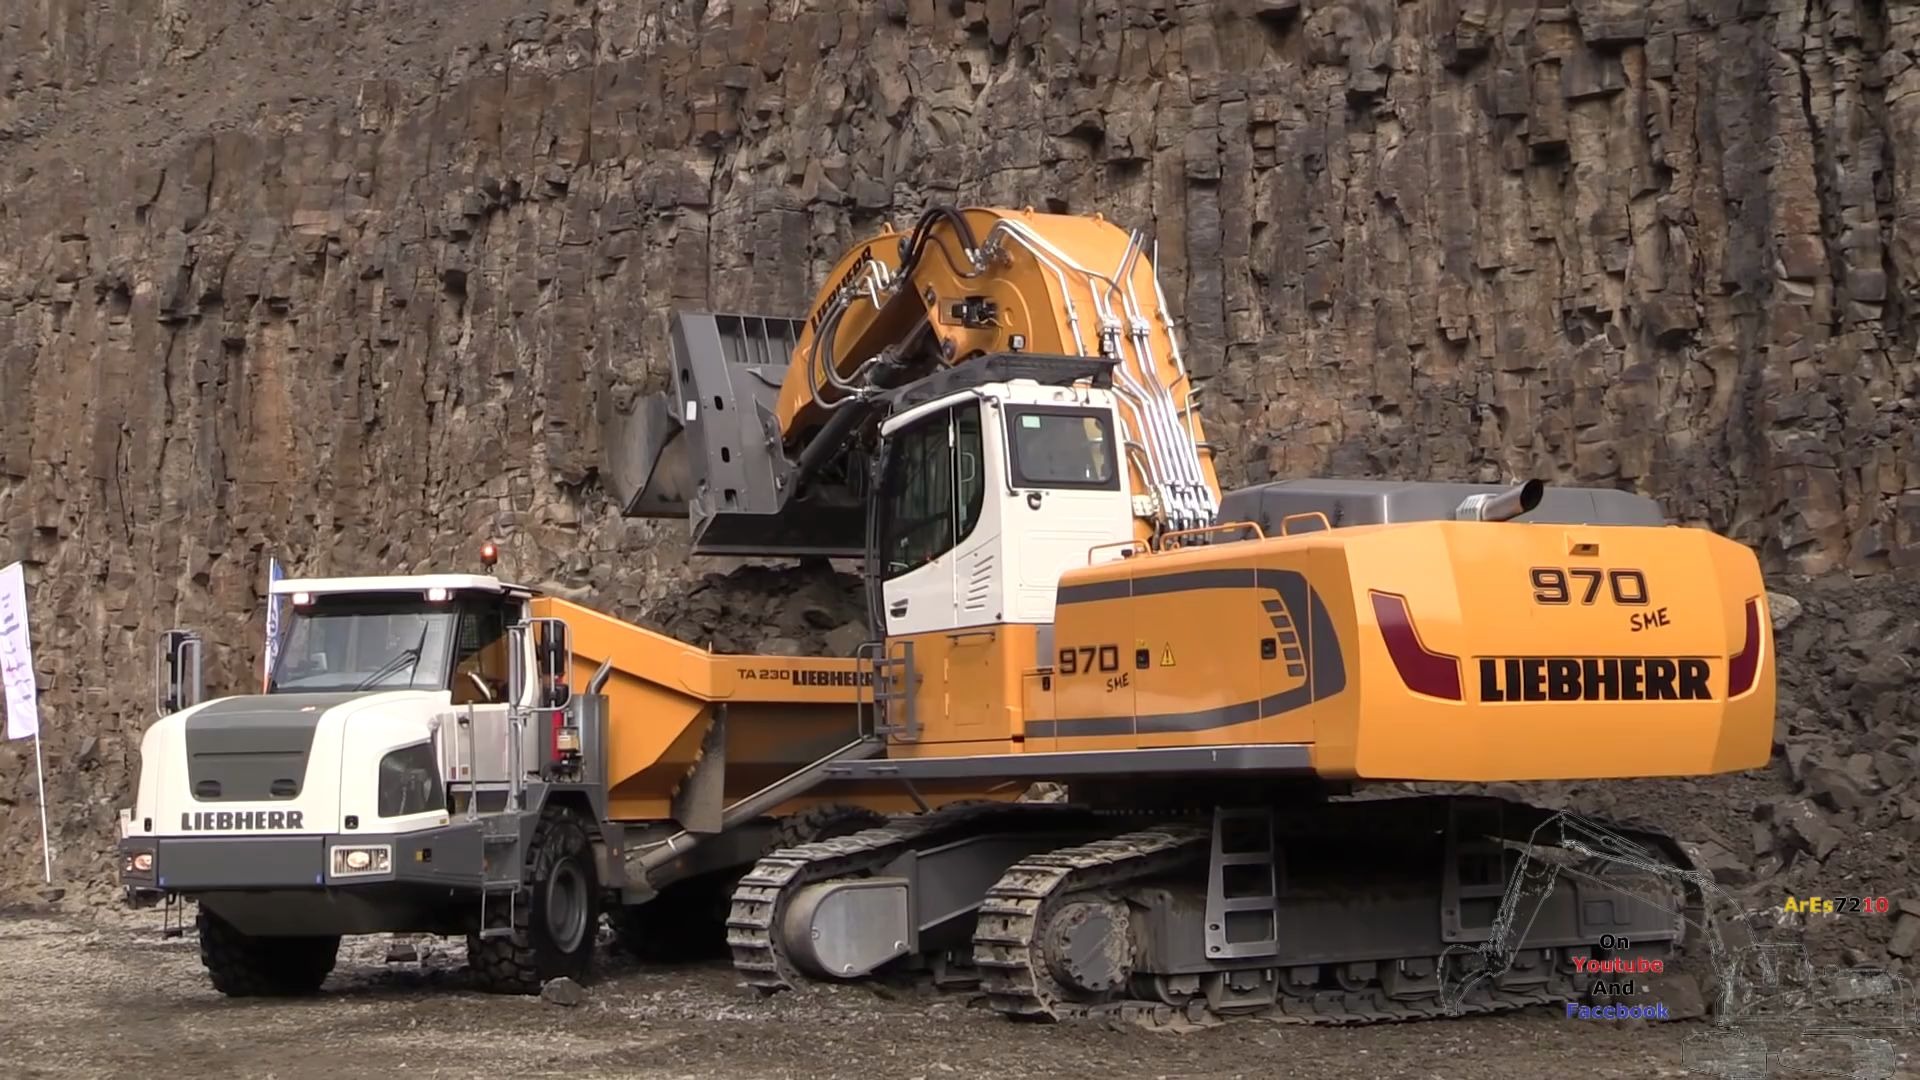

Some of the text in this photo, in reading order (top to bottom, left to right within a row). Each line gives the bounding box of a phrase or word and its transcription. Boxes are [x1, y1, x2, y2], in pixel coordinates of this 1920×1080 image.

[1529, 567, 1650, 606] 970
[1630, 607, 1671, 632] SME
[1060, 646, 1118, 675] 970
[737, 669, 757, 679] TA
[759, 669, 790, 680] 230
[1106, 672, 1129, 693] SME
[1479, 659, 1712, 702] LIEBHERR
[181, 811, 304, 831] LIEBHERR
